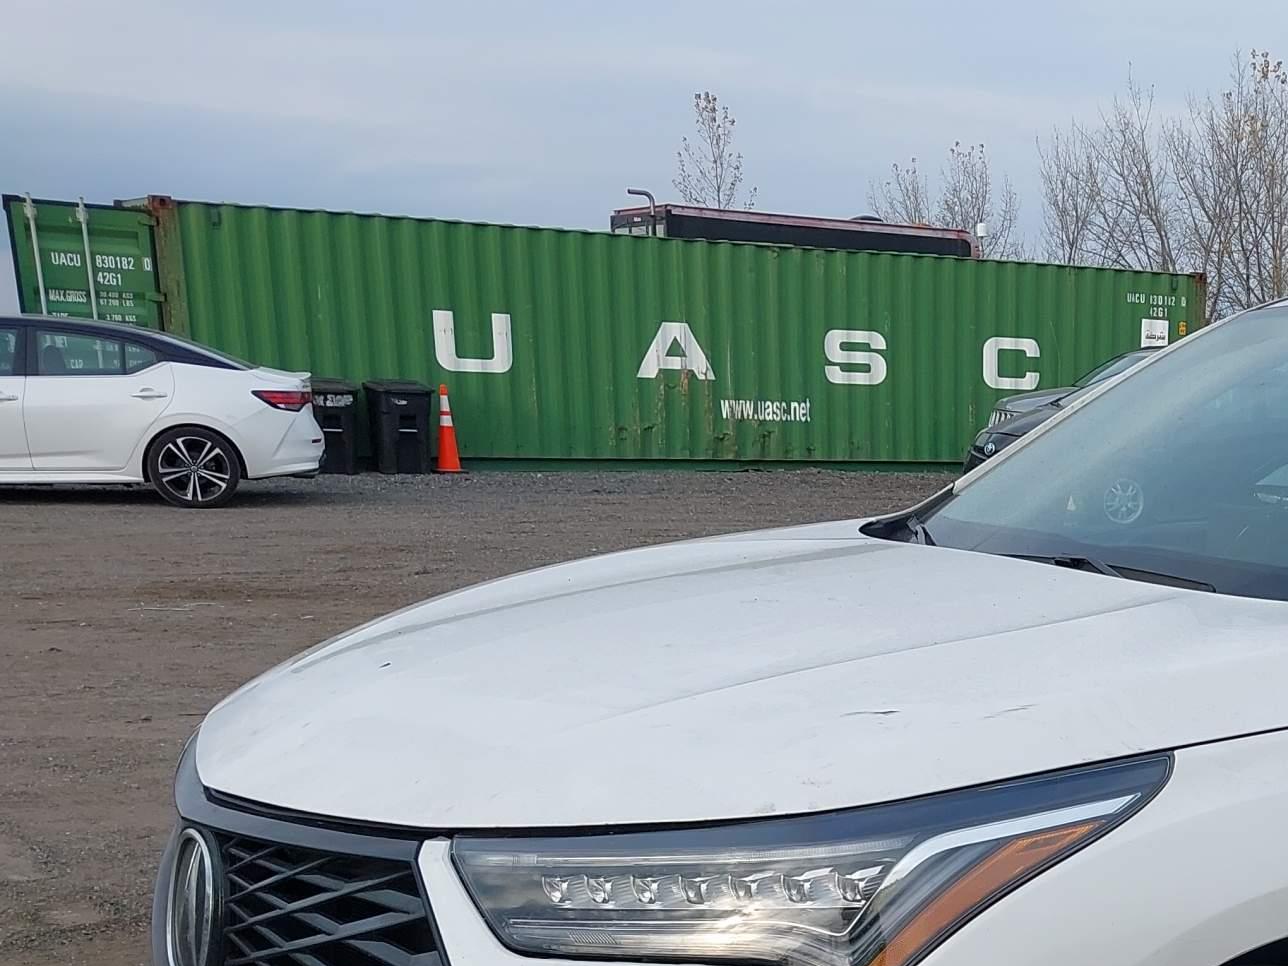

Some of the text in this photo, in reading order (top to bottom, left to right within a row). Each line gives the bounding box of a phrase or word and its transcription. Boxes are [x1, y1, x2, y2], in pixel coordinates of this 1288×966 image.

[50, 252, 81, 267] UACU
[95, 254, 135, 270] 830182
[97, 271, 122, 286] 42G1
[720, 398, 811, 422] www.uasc.net
